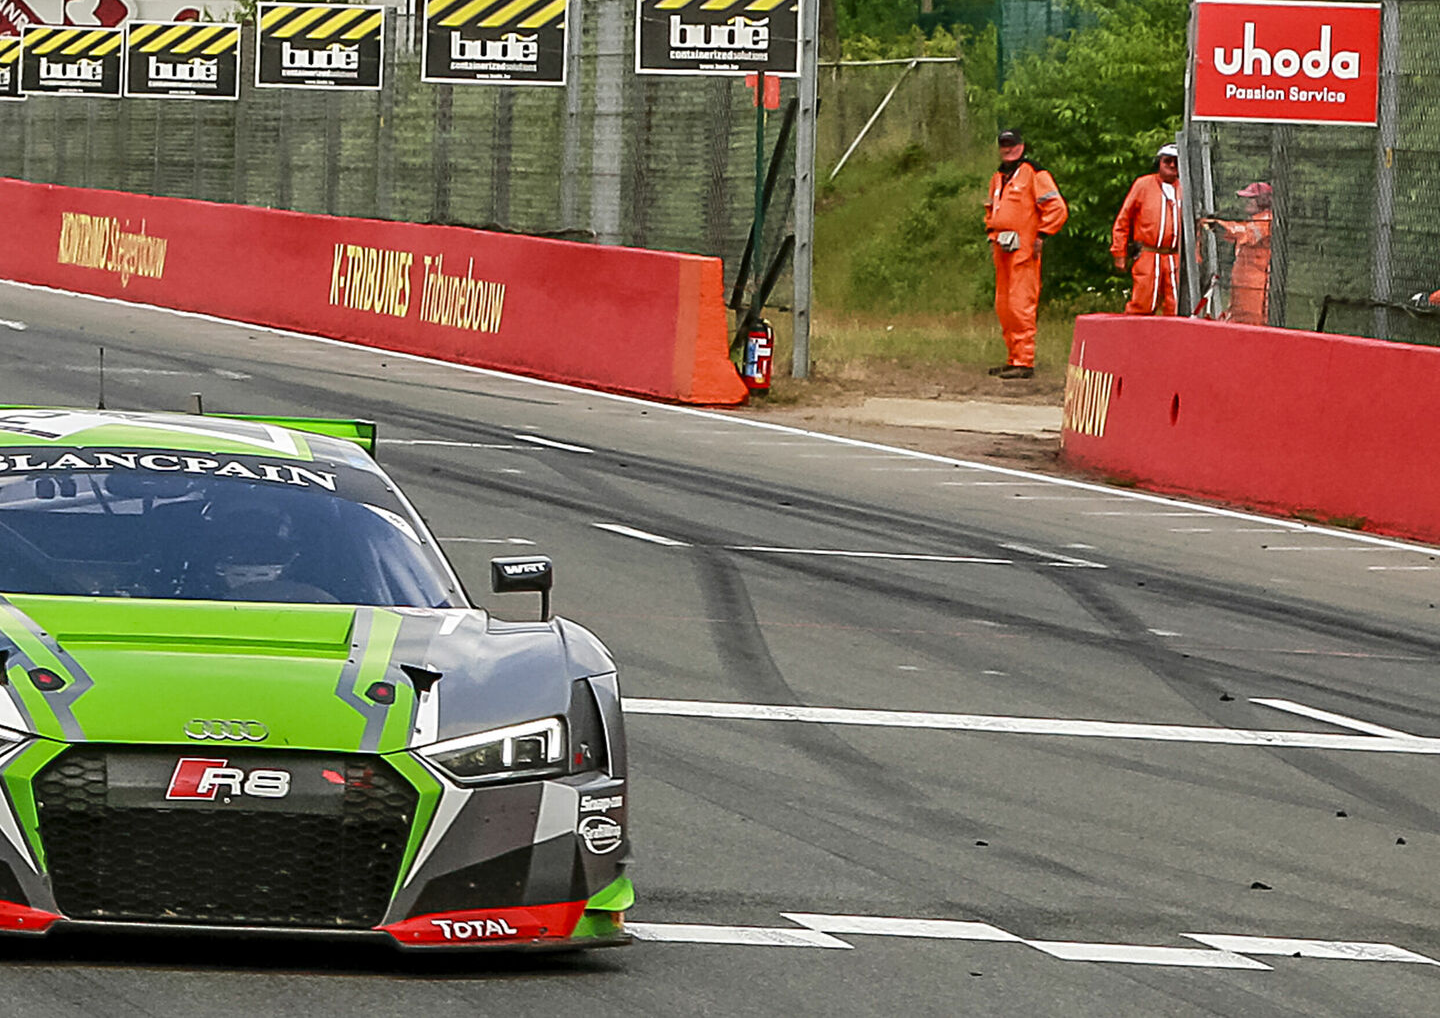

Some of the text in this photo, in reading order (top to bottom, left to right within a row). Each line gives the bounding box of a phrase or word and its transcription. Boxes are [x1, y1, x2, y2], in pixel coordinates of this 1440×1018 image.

[1214, 22, 1360, 79] uhoda
[1226, 84, 1346, 103] Passion Service
[329, 244, 506, 334] K-TRIBUNES Tribunebouw
[503, 563, 547, 575] WRT
[196, 767, 290, 798] R8
[431, 918, 518, 939] TOTAL
